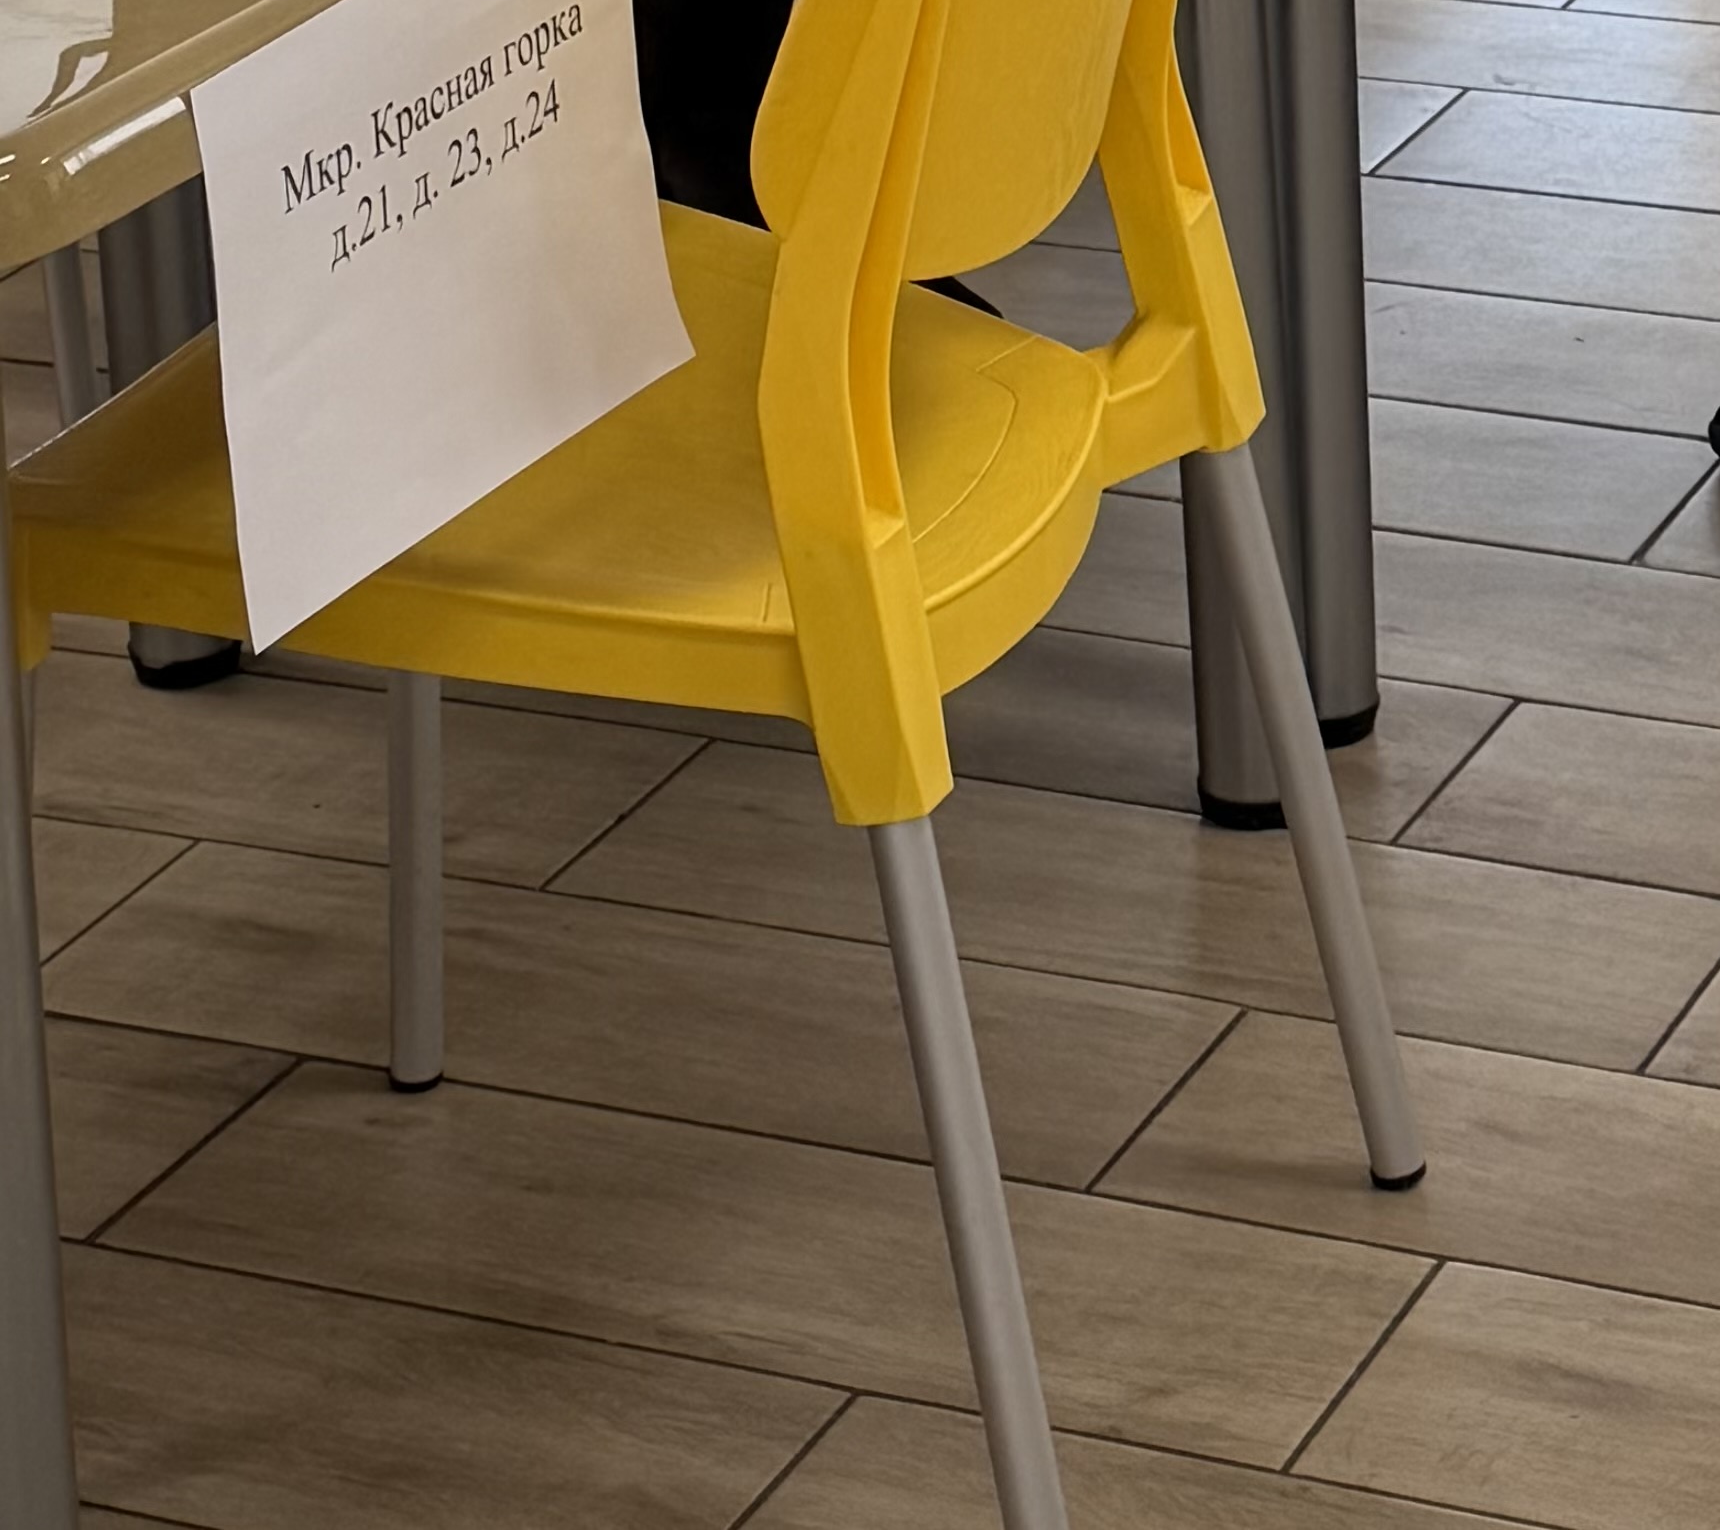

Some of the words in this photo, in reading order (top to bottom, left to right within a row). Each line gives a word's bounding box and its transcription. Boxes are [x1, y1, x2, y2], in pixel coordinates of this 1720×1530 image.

[281, 142, 362, 215] Мкр.
[371, 55, 496, 158] Красная
[503, 3, 584, 77] горка
[331, 184, 404, 273] д.21,
[412, 172, 439, 220] д.
[447, 128, 493, 187] 23,
[501, 78, 561, 163] д.24
